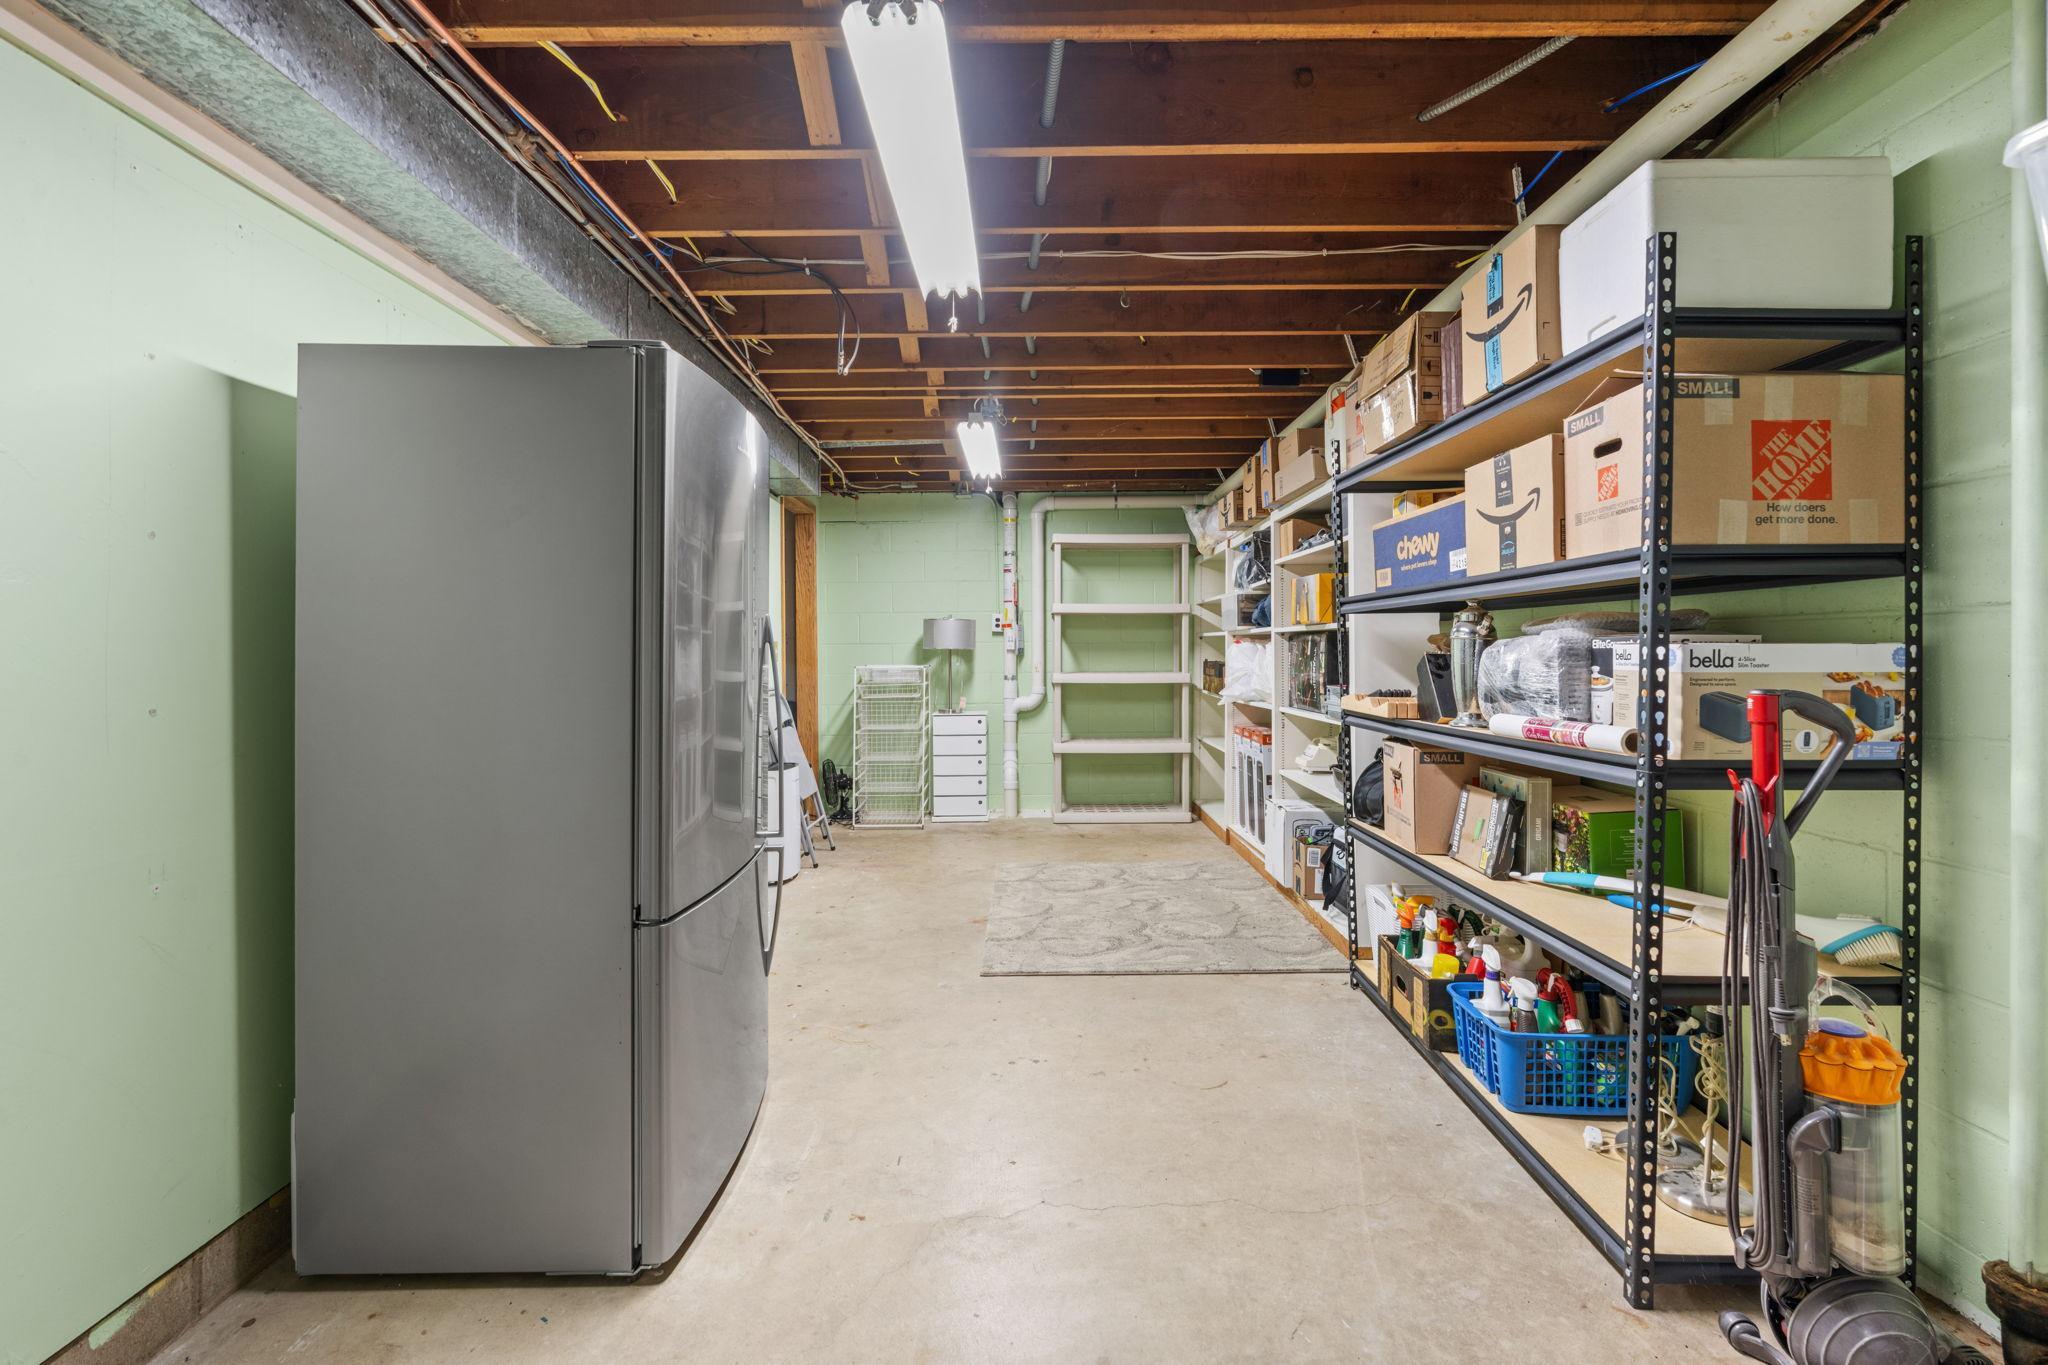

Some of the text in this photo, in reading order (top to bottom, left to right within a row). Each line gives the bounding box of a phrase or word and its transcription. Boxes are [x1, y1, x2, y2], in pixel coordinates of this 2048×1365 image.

[1677, 381, 1734, 395] SMALL
[1570, 411, 1601, 433] SMALL
[1759, 427, 1793, 461] THE
[1752, 420, 1831, 500] HOME
[1783, 450, 1832, 500] DEPOT
[1766, 502, 1826, 512] How doers
[1755, 514, 1838, 525] get more done.
[1396, 531, 1440, 560] chewy
[1615, 649, 1632, 661] bella
[1690, 648, 1734, 668] bella
[1423, 753, 1460, 762] SMALL
